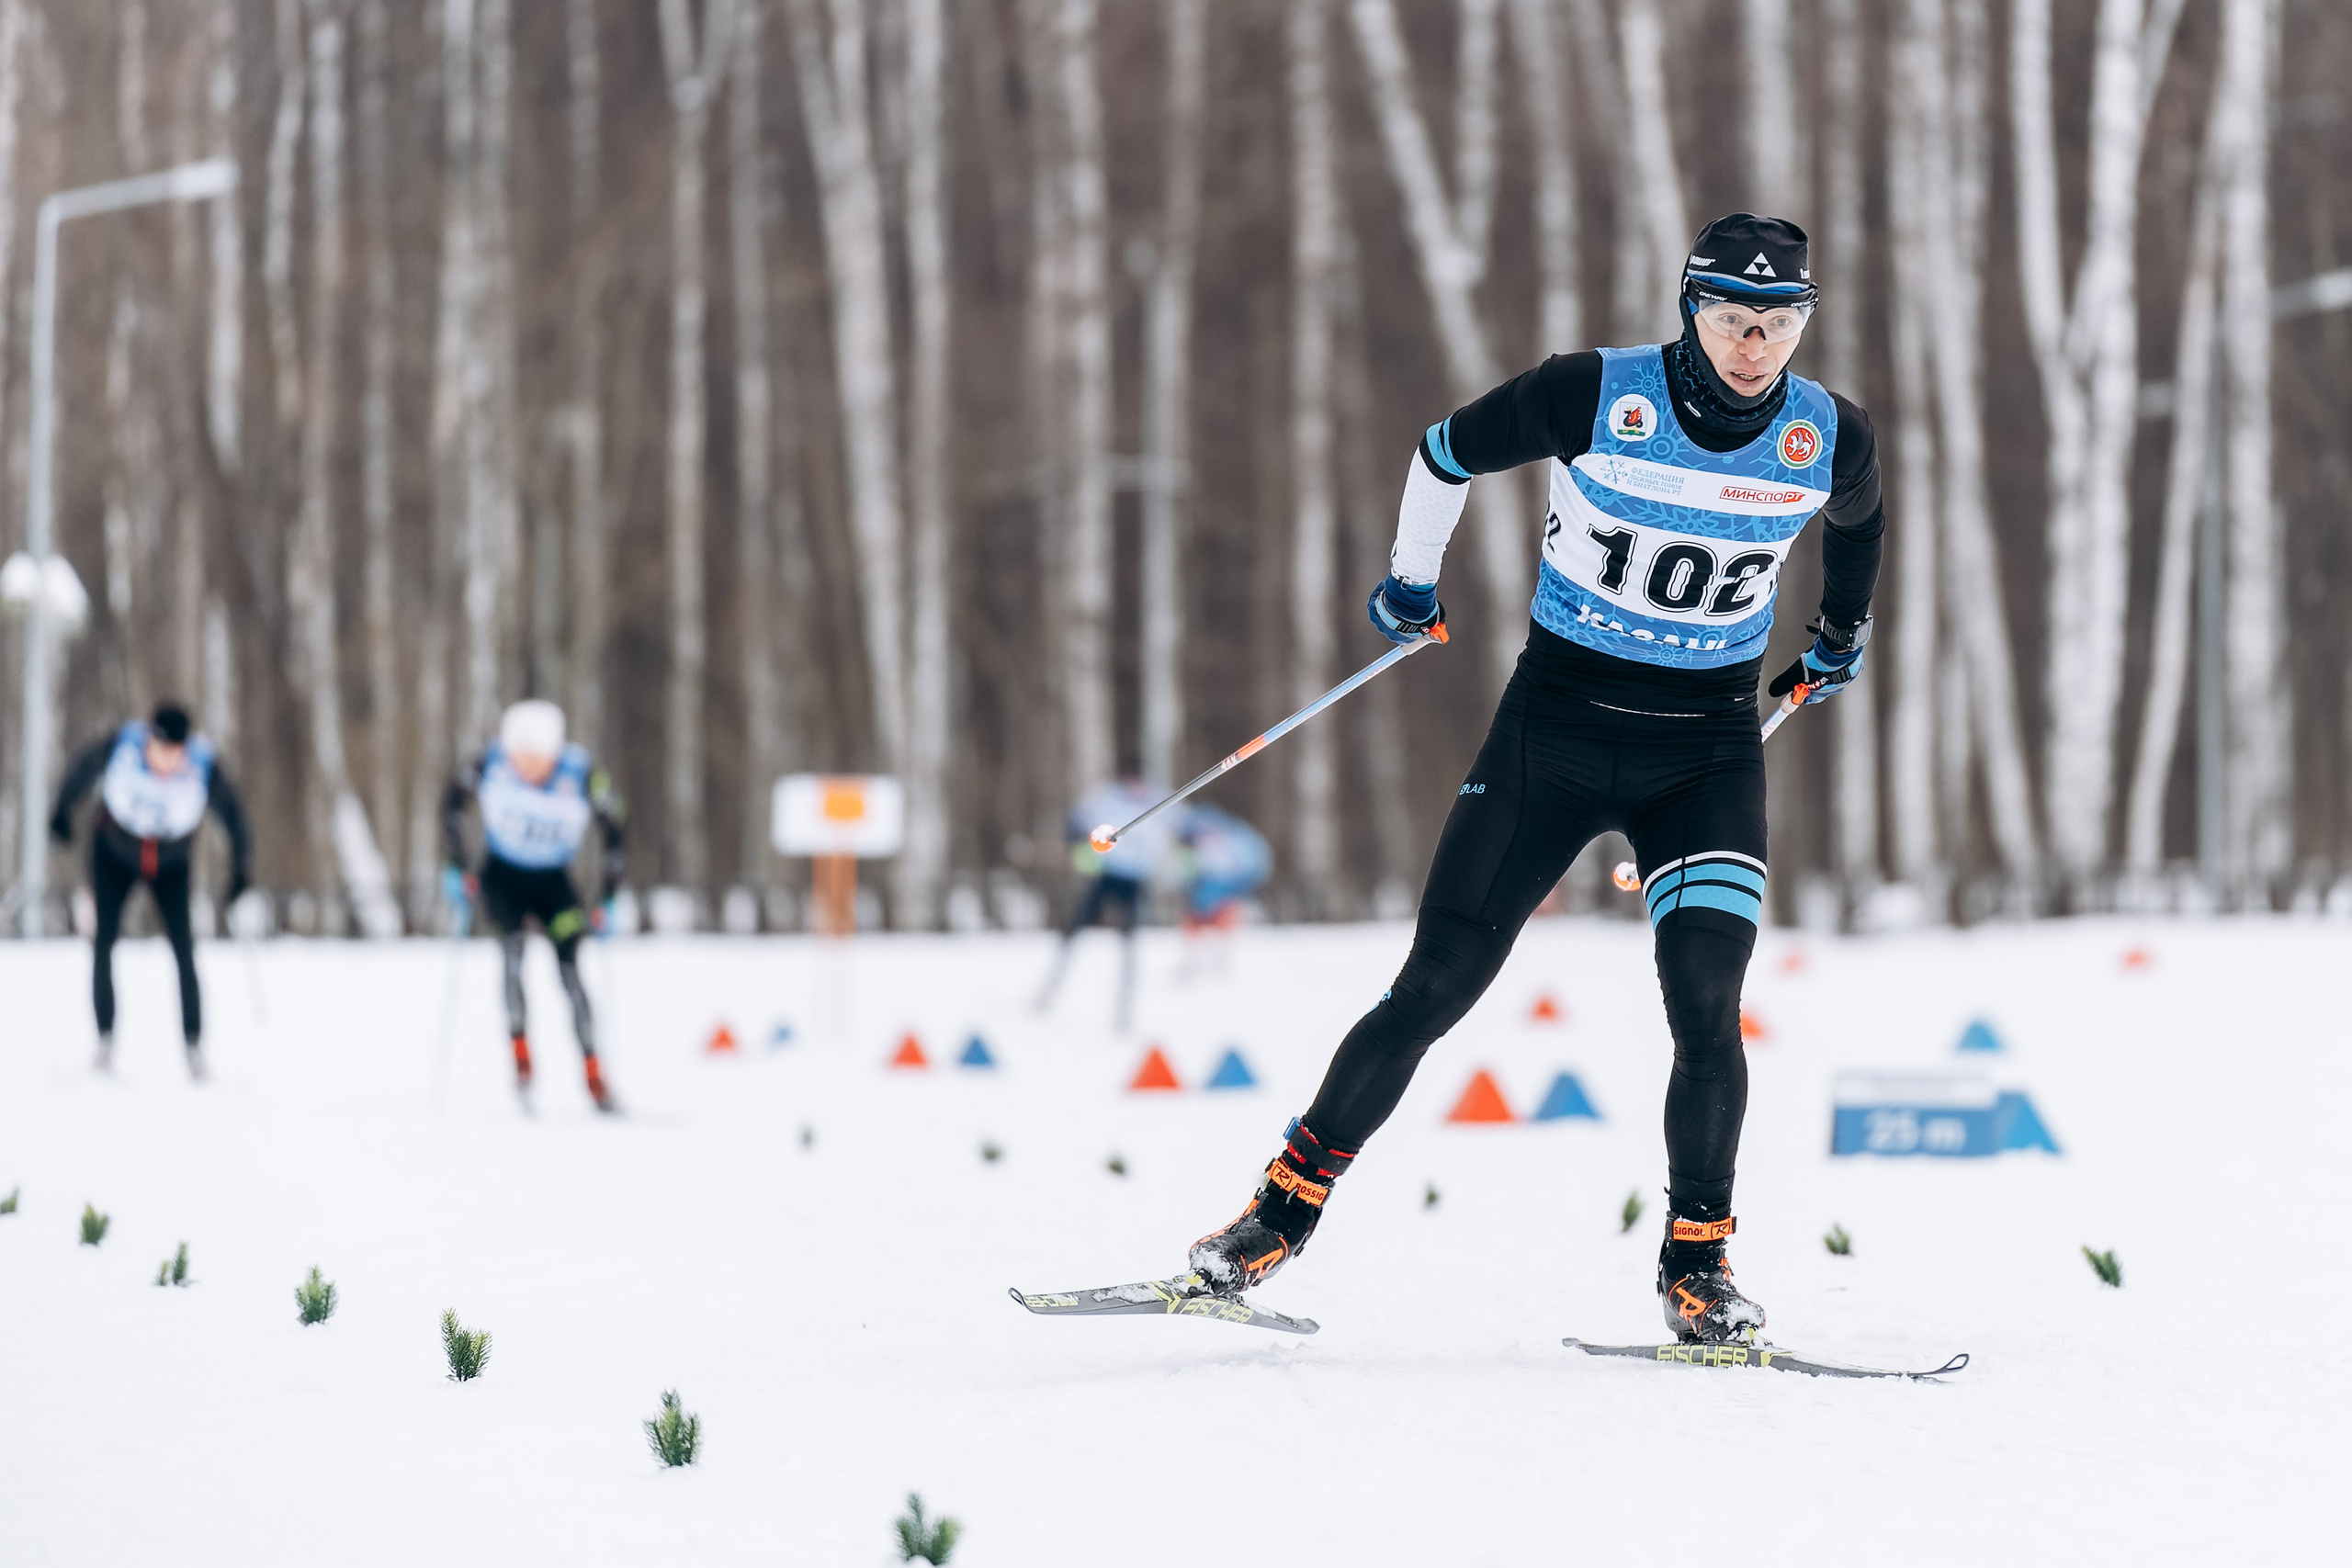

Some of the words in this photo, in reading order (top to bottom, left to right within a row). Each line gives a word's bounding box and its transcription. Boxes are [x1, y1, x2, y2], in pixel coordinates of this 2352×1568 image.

[1631, 467, 1685, 484] ФЕДЕРАЦИЯ
[1633, 480, 1671, 494] БИАТЛОНА
[1660, 480, 1683, 491] ГОНОК
[1723, 488, 1802, 502] МИНСПОРТ
[1587, 523, 1779, 616] 102
[1179, 1296, 1255, 1324] FISCHER
[1656, 1344, 1748, 1367] FISCHER
